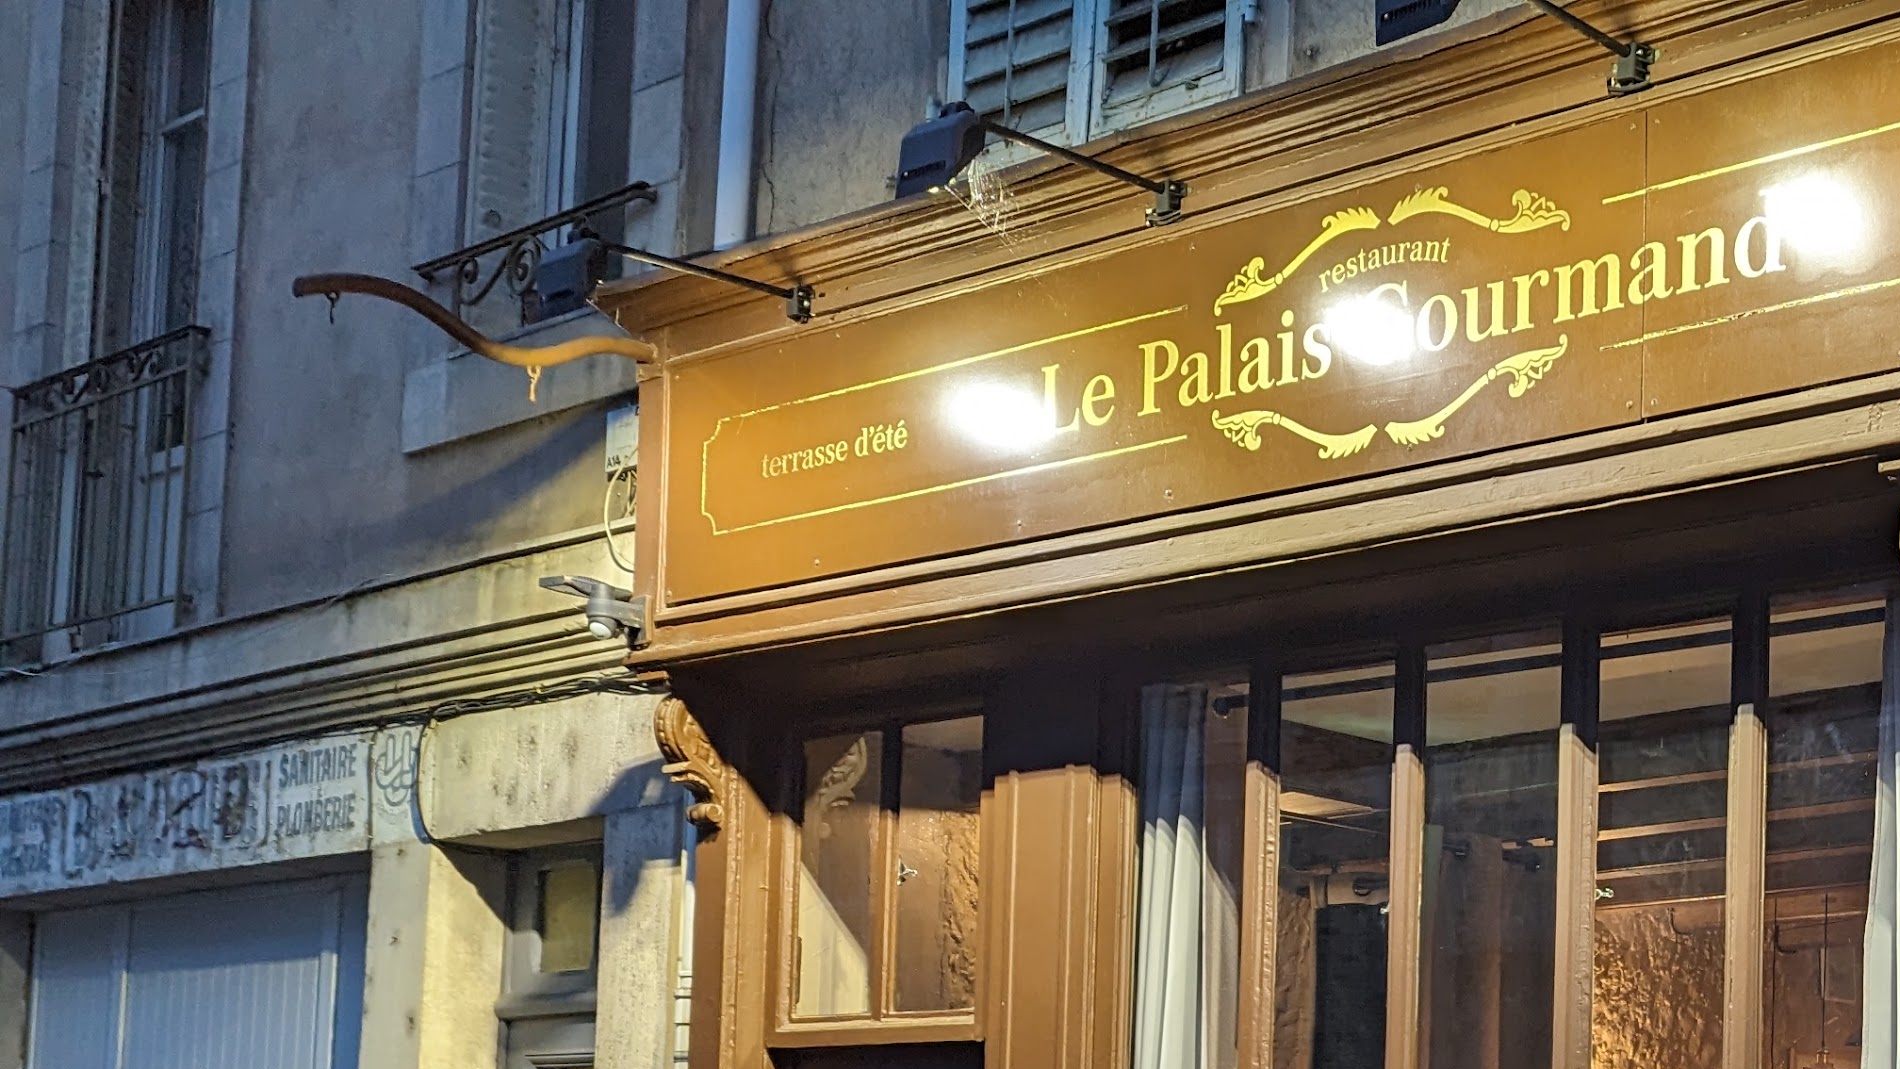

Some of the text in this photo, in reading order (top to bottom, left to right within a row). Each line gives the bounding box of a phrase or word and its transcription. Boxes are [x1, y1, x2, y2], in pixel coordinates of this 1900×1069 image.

[1318, 236, 1450, 293] restaurant
[1038, 364, 1116, 437] Le
[1138, 310, 1333, 415] Palais
[761, 419, 907, 479] terrasse d'été
[278, 743, 357, 788] SANITAIRE
[276, 793, 356, 836] PLOMBERIE
